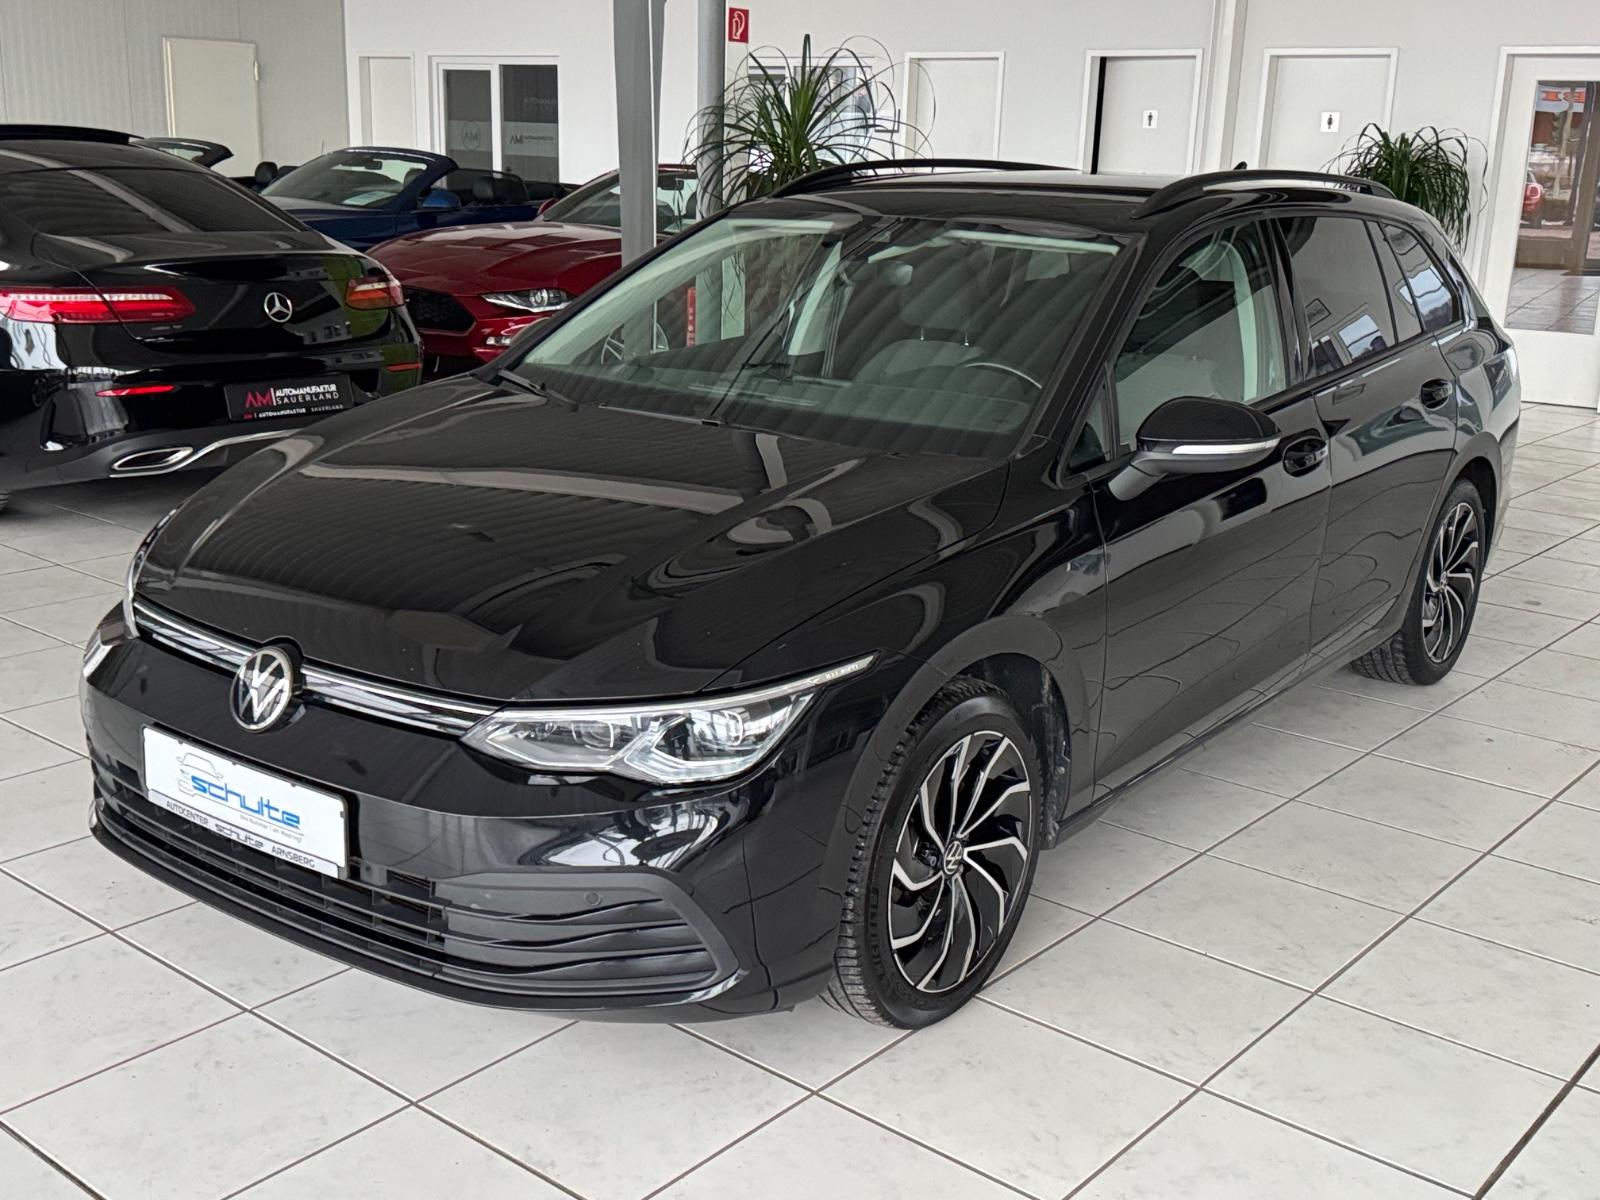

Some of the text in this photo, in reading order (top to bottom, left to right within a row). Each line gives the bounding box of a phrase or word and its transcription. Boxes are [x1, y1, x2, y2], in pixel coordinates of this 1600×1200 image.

[245, 384, 337, 408] AM AUTOMANUFAKTUR
[276, 392, 339, 405] SAUERLAND
[191, 775, 301, 829] schulte
[166, 800, 209, 825] AUTOCENTER
[271, 846, 316, 868] ARNSBERG
